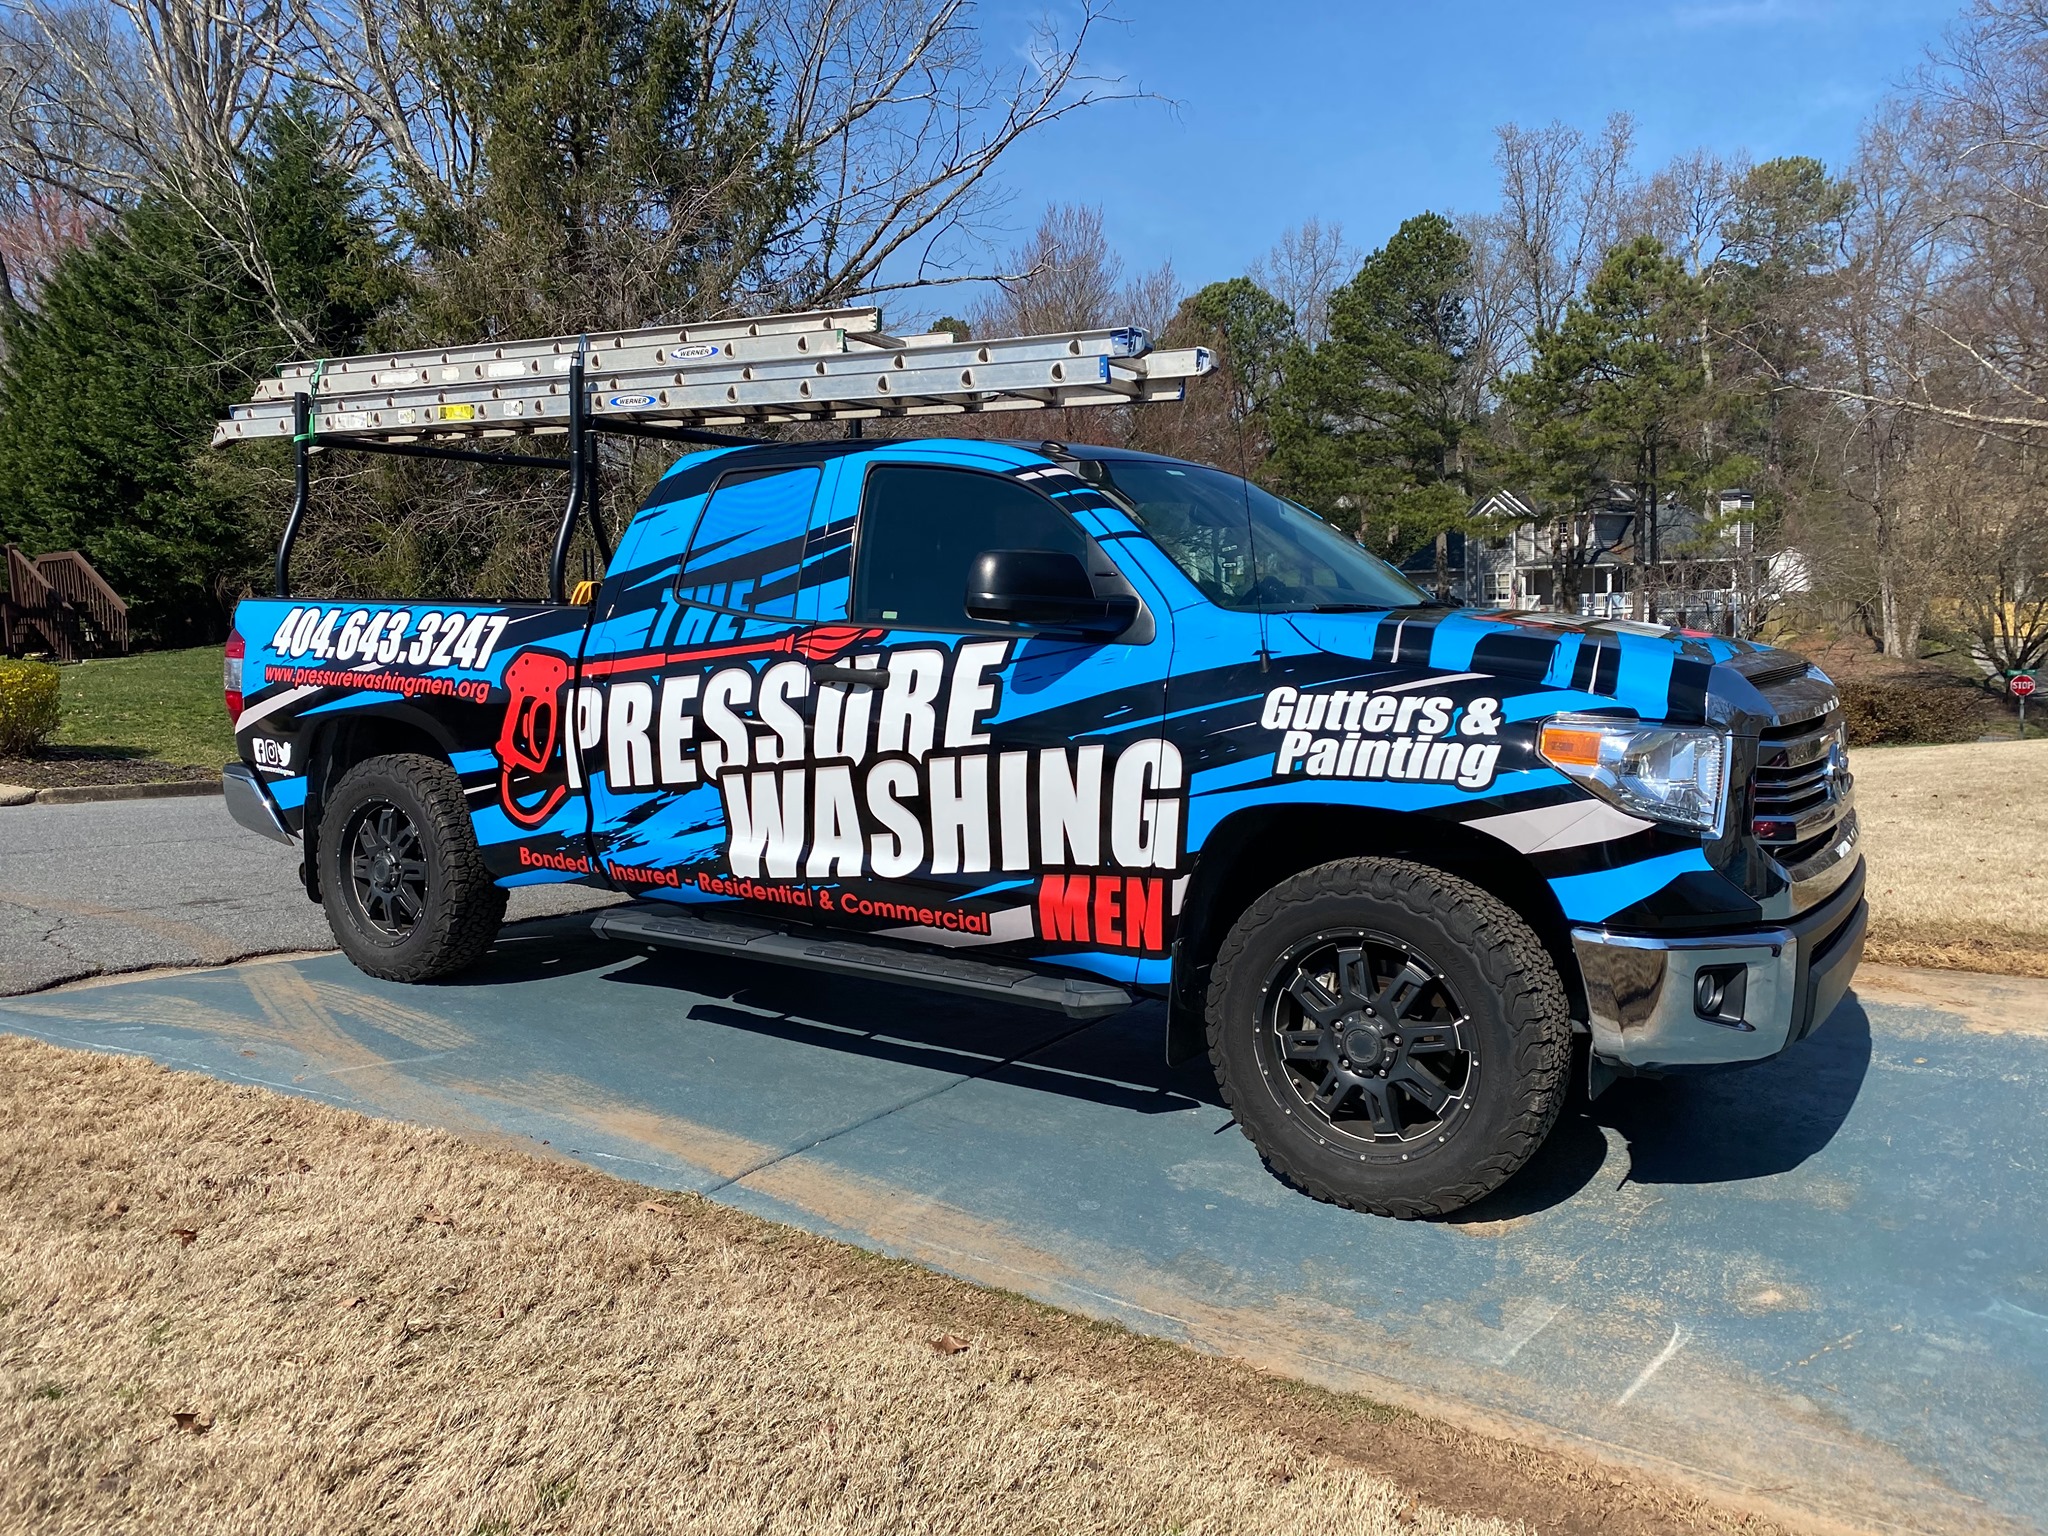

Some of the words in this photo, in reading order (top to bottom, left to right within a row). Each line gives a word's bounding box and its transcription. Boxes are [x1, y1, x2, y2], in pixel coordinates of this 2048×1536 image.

[680, 348, 709, 357] WERNER
[619, 397, 648, 405] WERNER
[272, 607, 509, 670] 404.643.3247
[649, 579, 755, 648] THE
[264, 665, 490, 704] www.pressurewashingmen.org
[1261, 686, 1453, 733] Gutters
[1460, 697, 1502, 736] &
[2012, 682, 2034, 690] STOP
[565, 640, 1009, 790] PRESSURE
[1276, 730, 1502, 788] Painting
[721, 738, 1183, 879] WASHING
[519, 846, 589, 873] Bonded
[609, 861, 679, 887] Insured
[698, 872, 813, 907] Residential
[819, 889, 835, 911] &
[841, 893, 989, 933] Commercial
[1039, 874, 1163, 950] MEN
